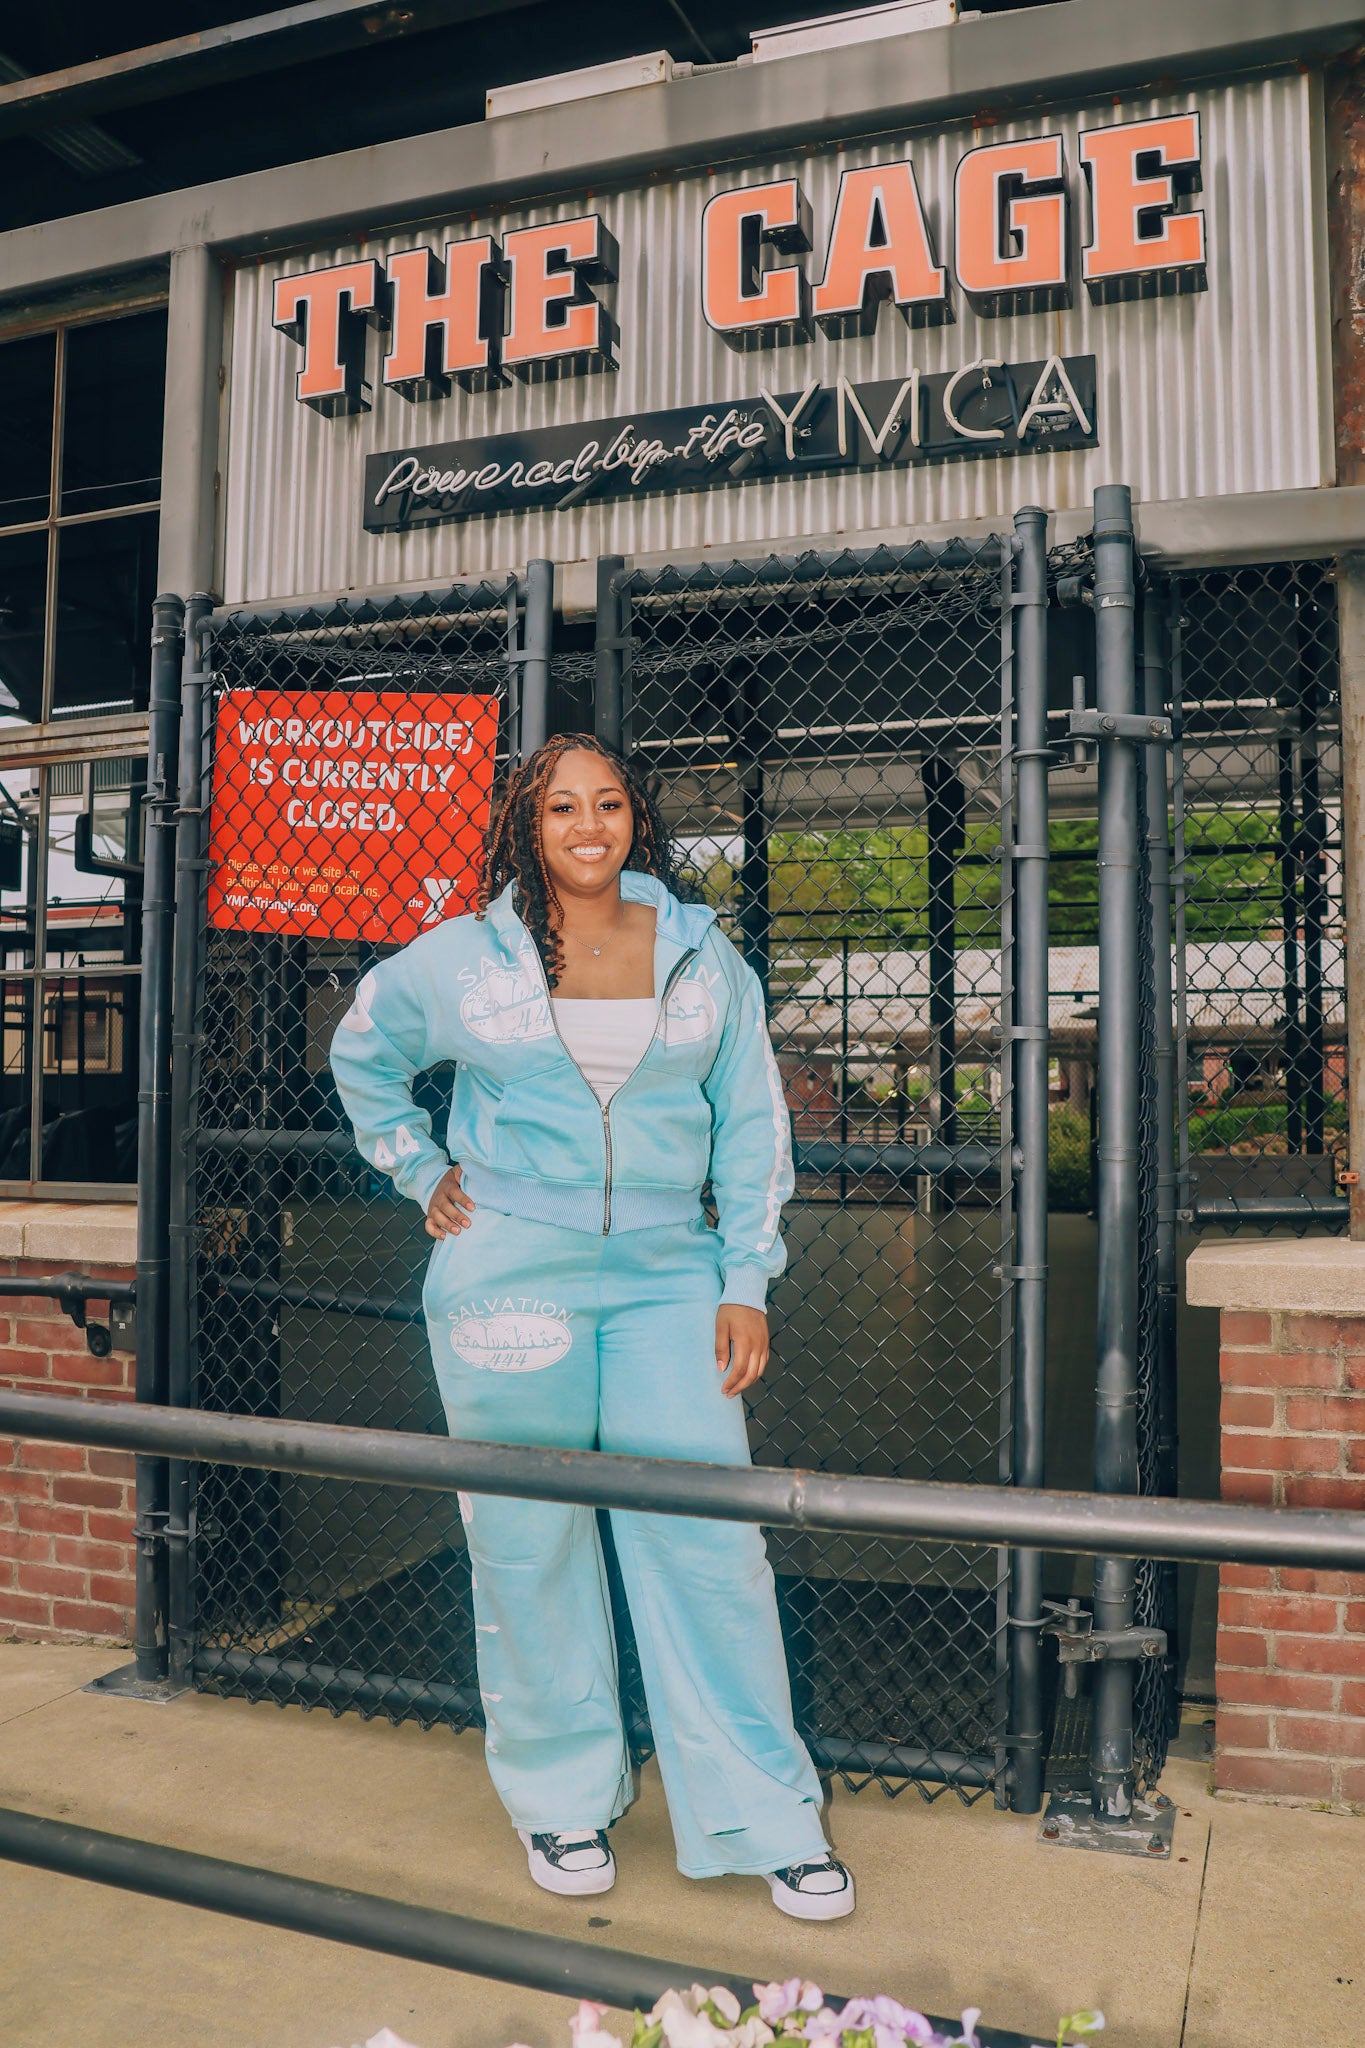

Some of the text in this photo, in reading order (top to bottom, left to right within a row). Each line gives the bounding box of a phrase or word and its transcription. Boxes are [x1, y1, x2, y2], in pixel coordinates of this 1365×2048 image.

[272, 112, 1206, 403] THE CAGE
[374, 355, 1093, 507] Powered by the YMCA
[238, 717, 474, 754] WORKOUT(SIDE)
[249, 757, 456, 793] IS CURRENTLY
[286, 799, 404, 833] CLOSED.
[281, 865, 300, 876] or
[302, 865, 342, 879] wesite
[344, 868, 361, 879] or
[309, 883, 329, 895] and
[408, 897, 424, 909] the
[447, 1297, 575, 1325] SALVATION
